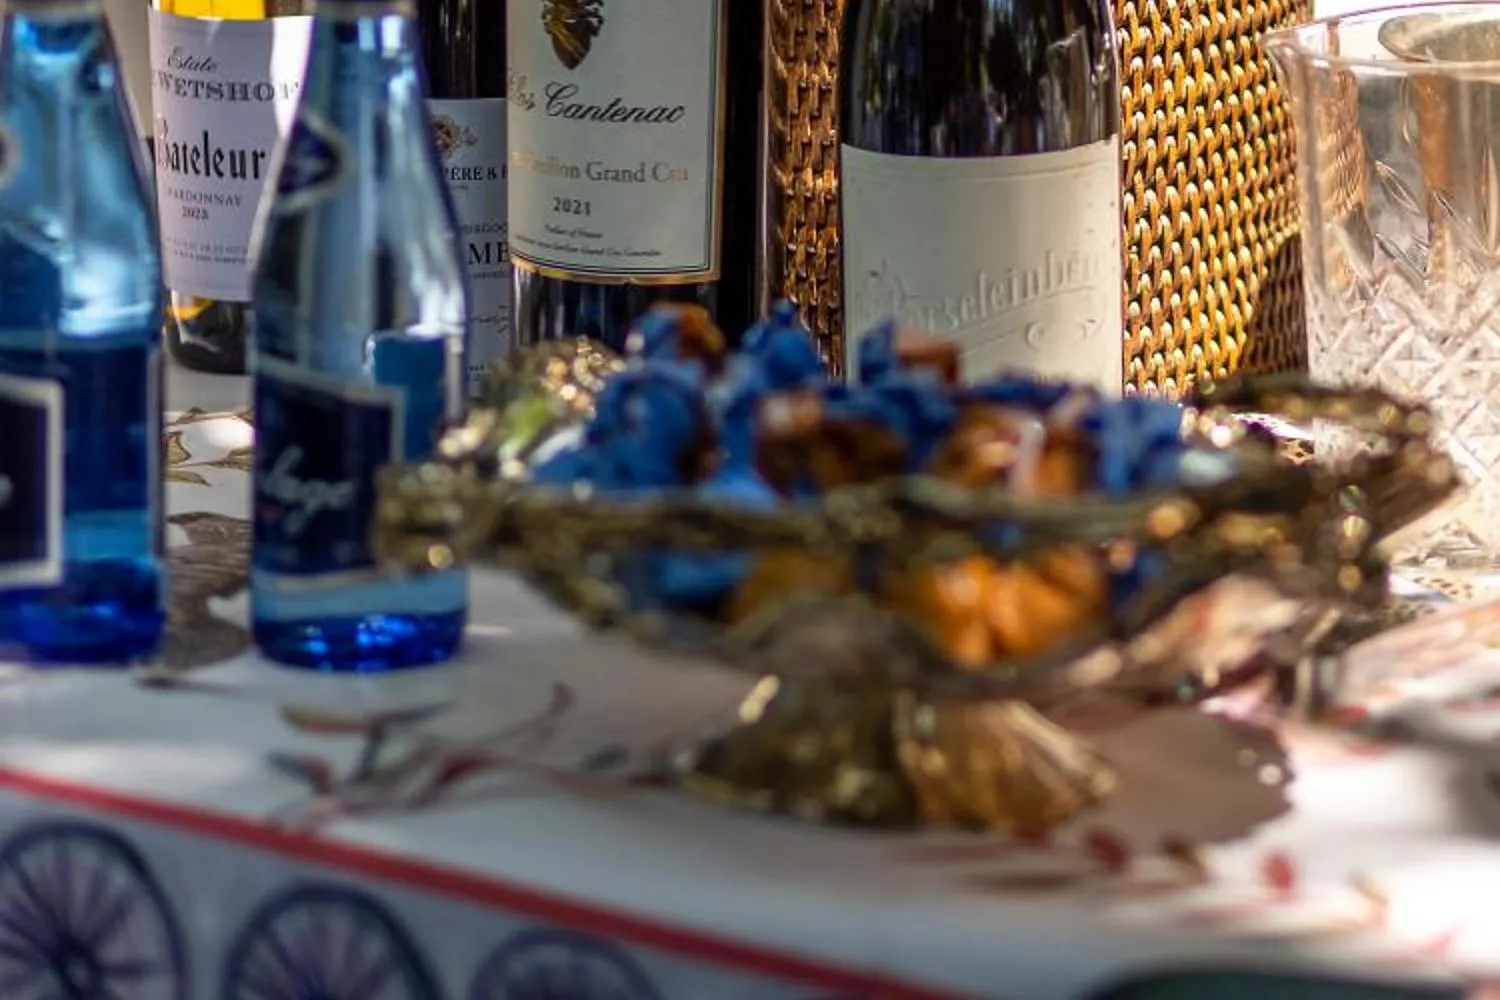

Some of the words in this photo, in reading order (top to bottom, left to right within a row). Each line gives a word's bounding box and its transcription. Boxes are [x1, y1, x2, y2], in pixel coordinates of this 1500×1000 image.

[167, 46, 218, 73] Estate
[545, 81, 686, 124] Cantenac
[586, 160, 647, 184] Grand
[552, 196, 592, 217] 2021
